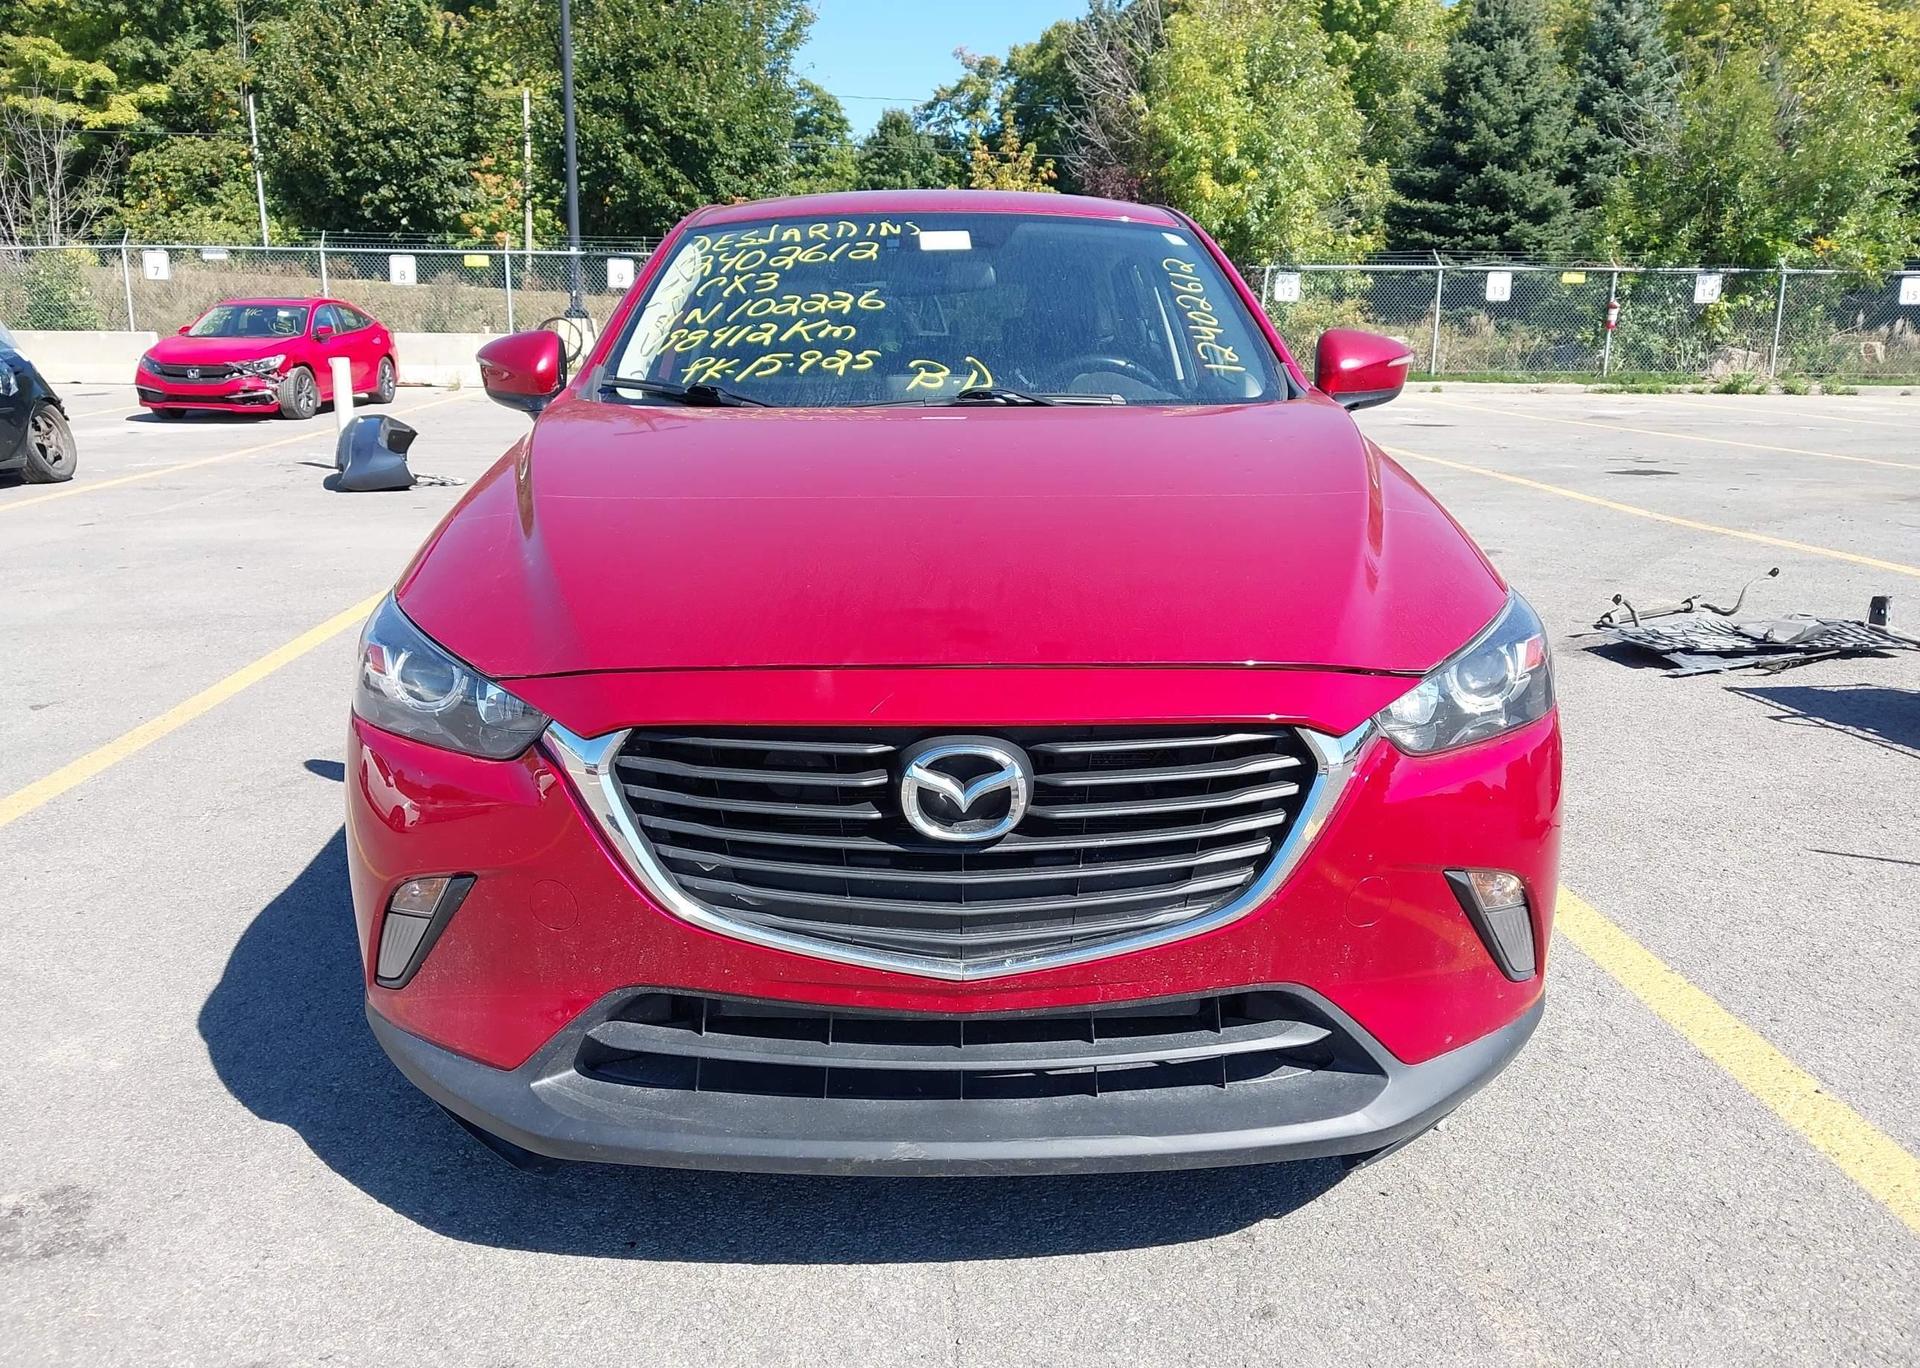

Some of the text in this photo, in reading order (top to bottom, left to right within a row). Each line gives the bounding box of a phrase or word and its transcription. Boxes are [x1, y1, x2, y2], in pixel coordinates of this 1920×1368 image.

[691, 220, 922, 254] DESJARDINS
[153, 266, 160, 276] 7
[400, 270, 406, 280] 8
[617, 273, 624, 282] 9
[696, 272, 780, 298] CX3
[1282, 287, 1293, 297] 12
[1491, 286, 1505, 297] 13
[726, 289, 886, 323] 102226
